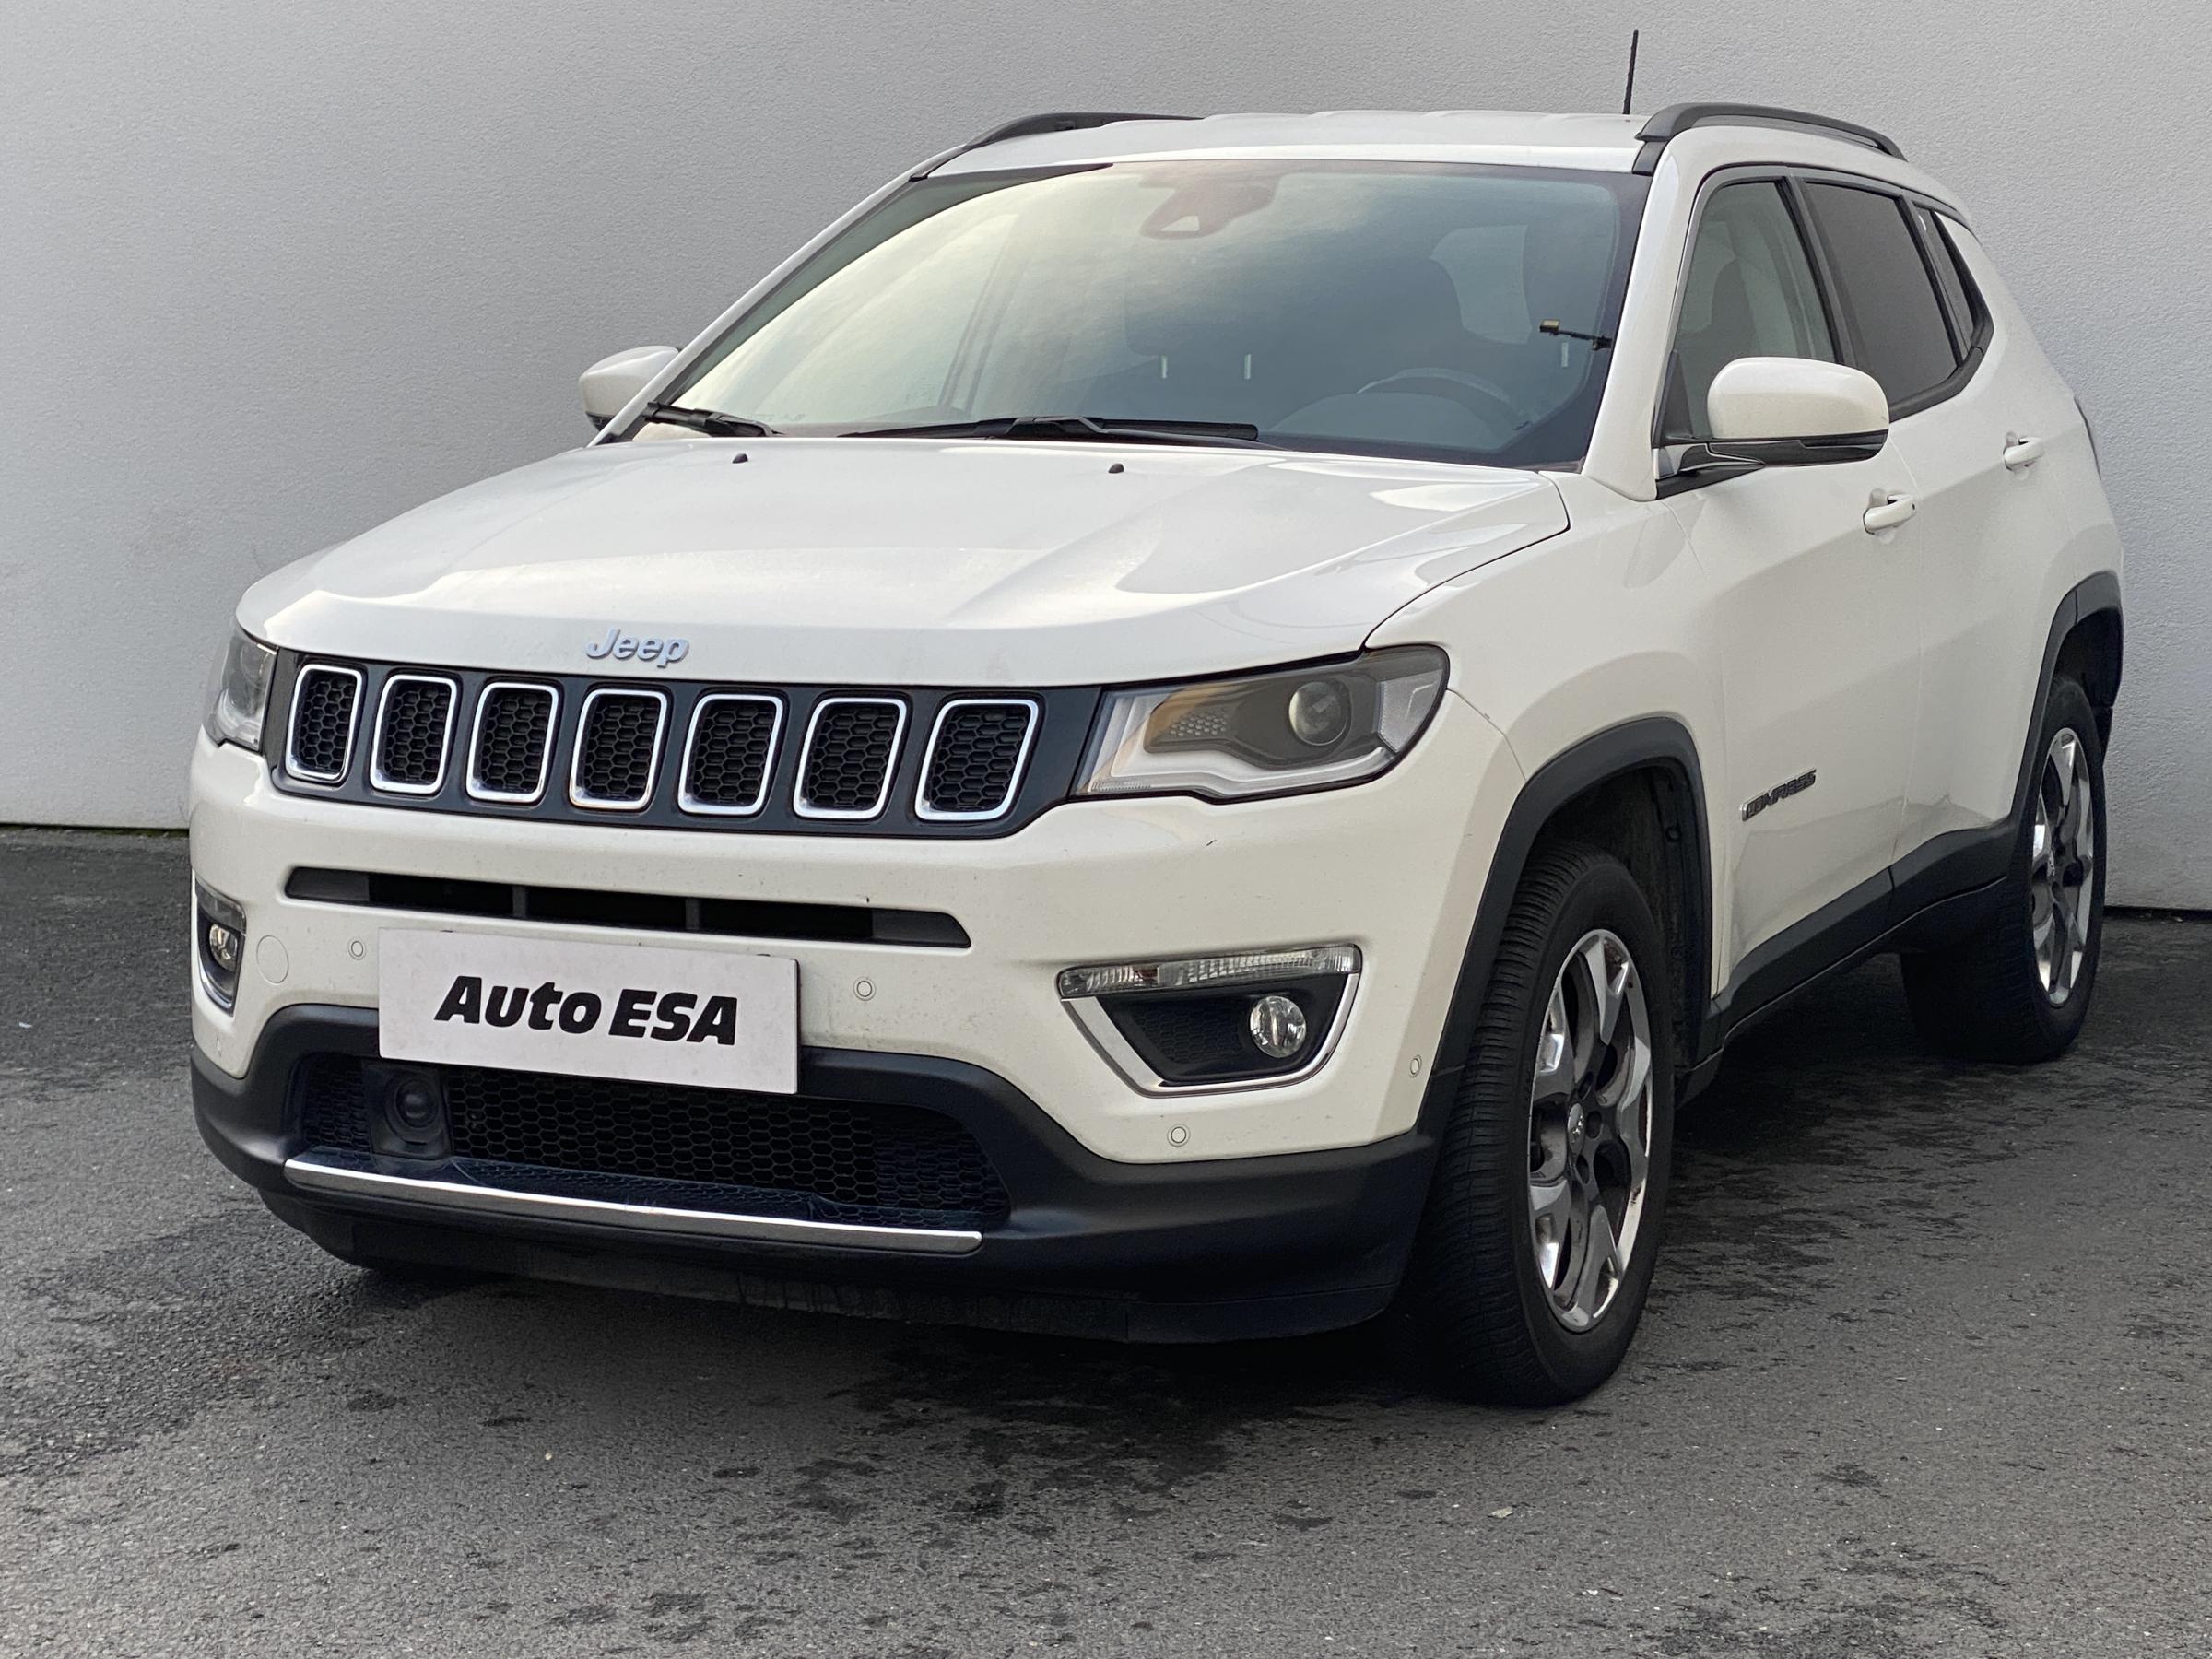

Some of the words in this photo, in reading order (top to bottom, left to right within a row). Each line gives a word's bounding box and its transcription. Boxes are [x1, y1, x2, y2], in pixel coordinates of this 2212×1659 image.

[586, 628, 689, 668] Jeep
[434, 975, 602, 1034] Auto
[608, 989, 737, 1046] ESA
